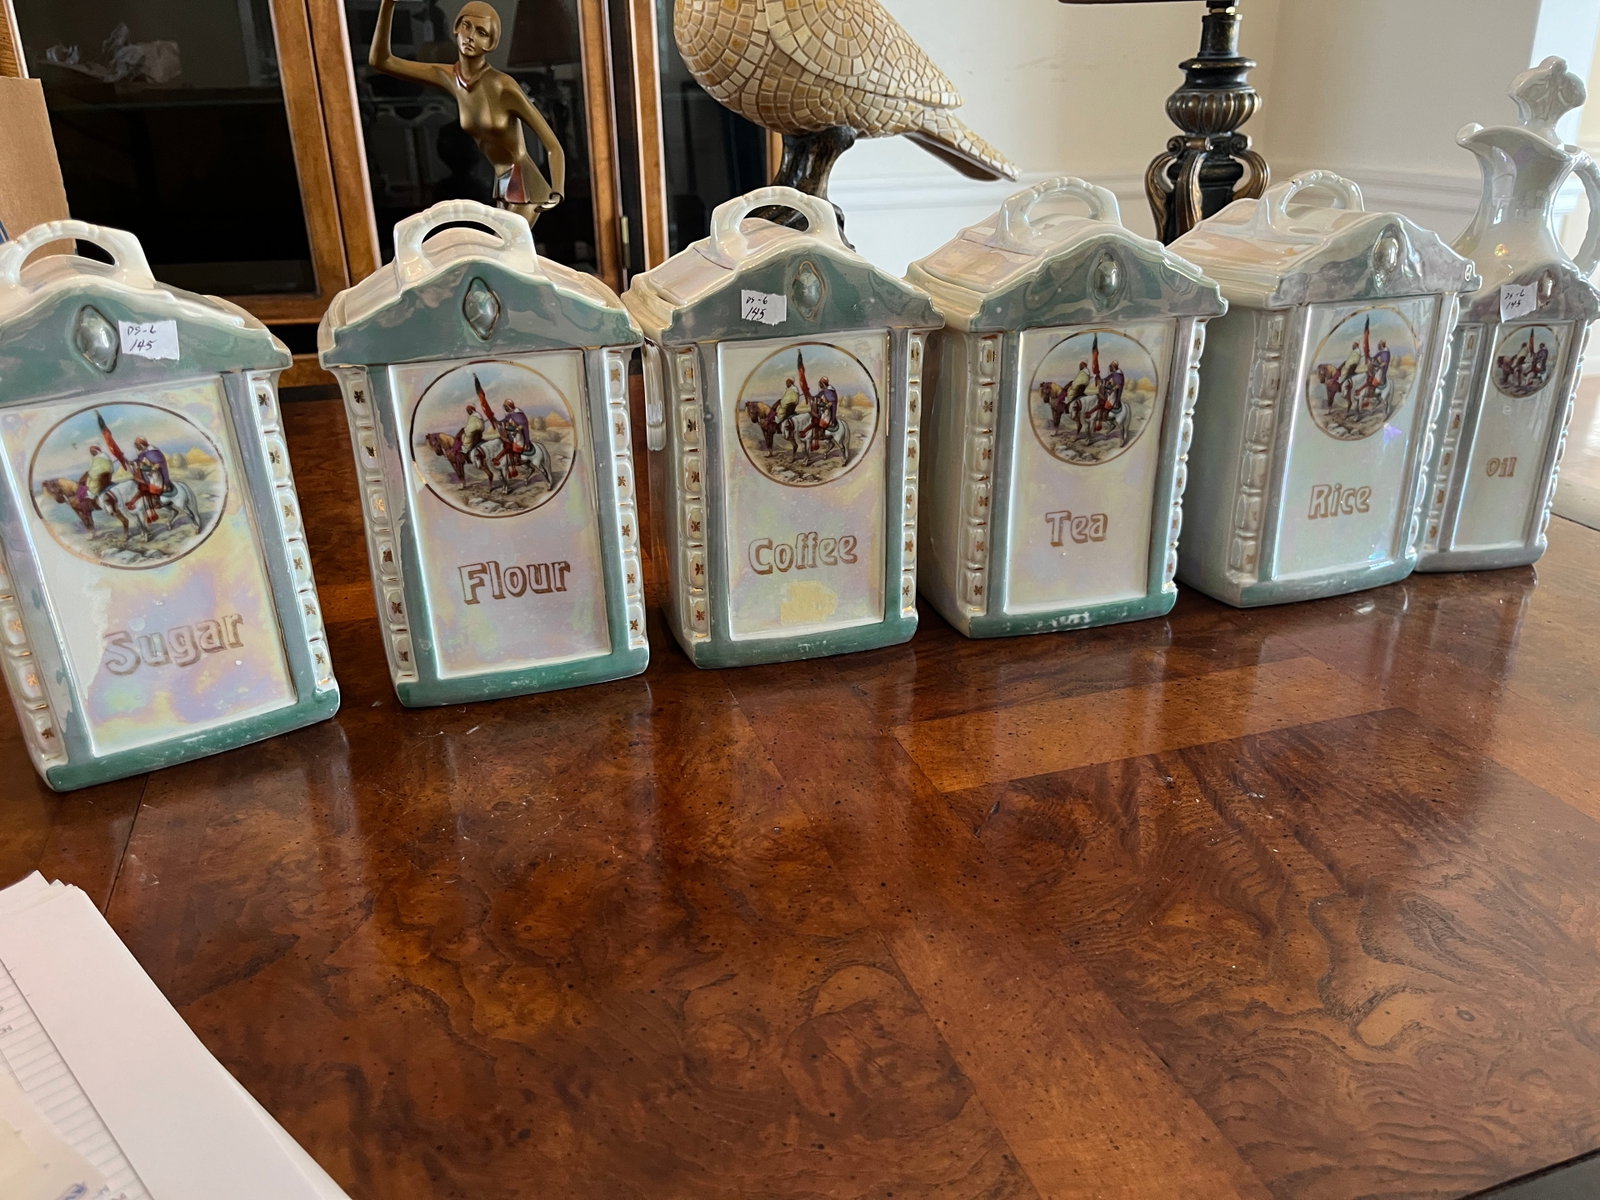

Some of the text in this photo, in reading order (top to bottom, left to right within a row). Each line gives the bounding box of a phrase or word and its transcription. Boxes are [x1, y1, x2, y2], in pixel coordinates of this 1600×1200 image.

[745, 307, 766, 320] 145
[129, 339, 158, 352] 145
[1307, 483, 1372, 520] Rice
[1044, 509, 1109, 547] Tea
[748, 531, 858, 575] Coffee
[457, 560, 571, 605] Flour
[103, 613, 244, 676] Sugar
